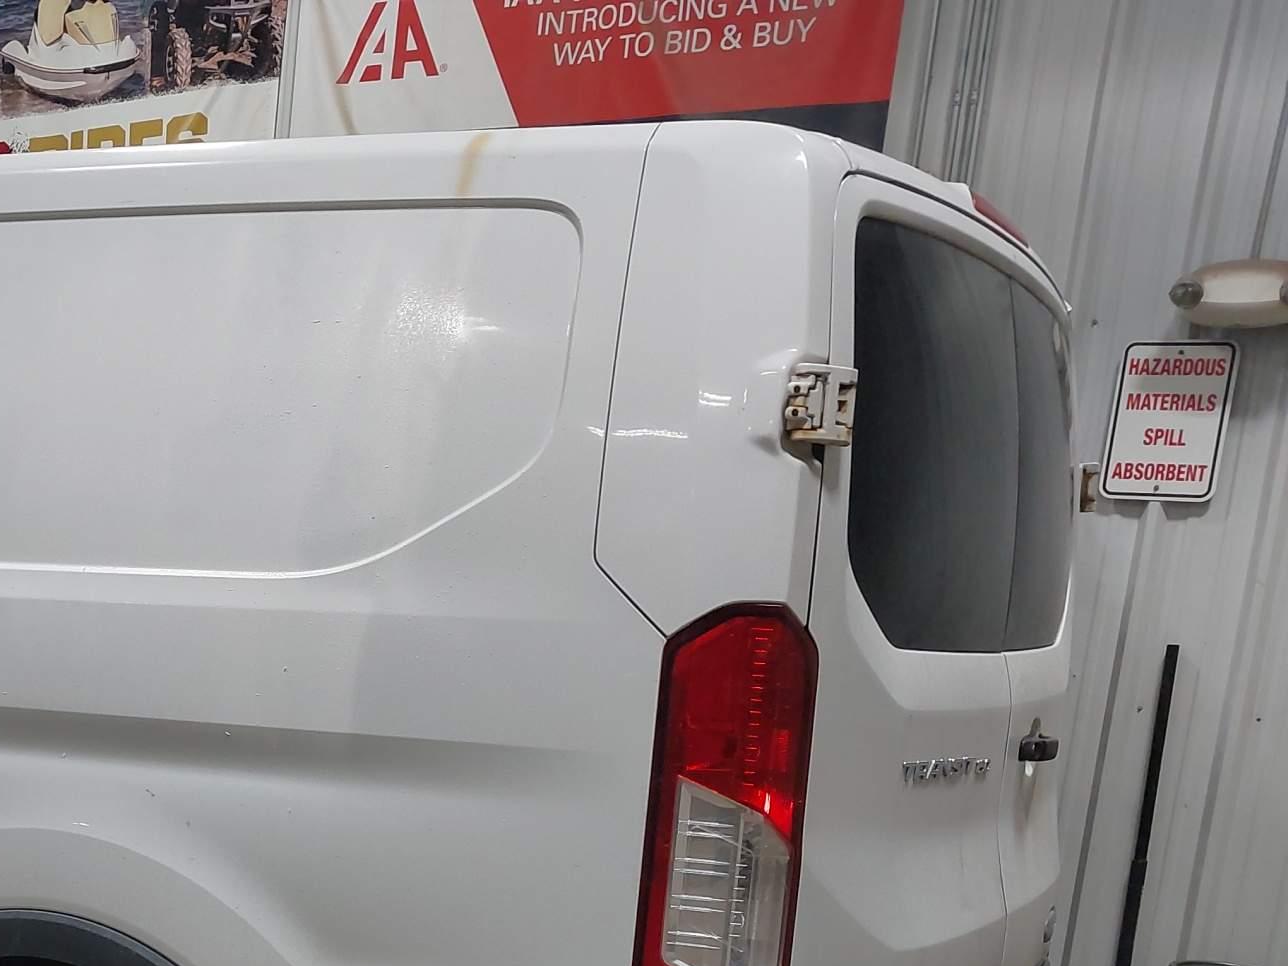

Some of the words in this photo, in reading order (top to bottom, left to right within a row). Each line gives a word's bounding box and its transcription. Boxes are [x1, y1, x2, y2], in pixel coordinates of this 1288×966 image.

[537, 0, 728, 36] INTRODUCING
[735, 0, 759, 16] A
[553, 36, 613, 66] WAY
[620, 31, 655, 60] TO
[664, 26, 712, 55] BID
[720, 24, 742, 50] &
[752, 17, 816, 48] BUY
[1128, 358, 1226, 376] HAZARDOUS
[1126, 393, 1217, 412] MATERIALS
[1143, 428, 1186, 446] SPILL
[1112, 462, 1208, 482] ABSORBENT
